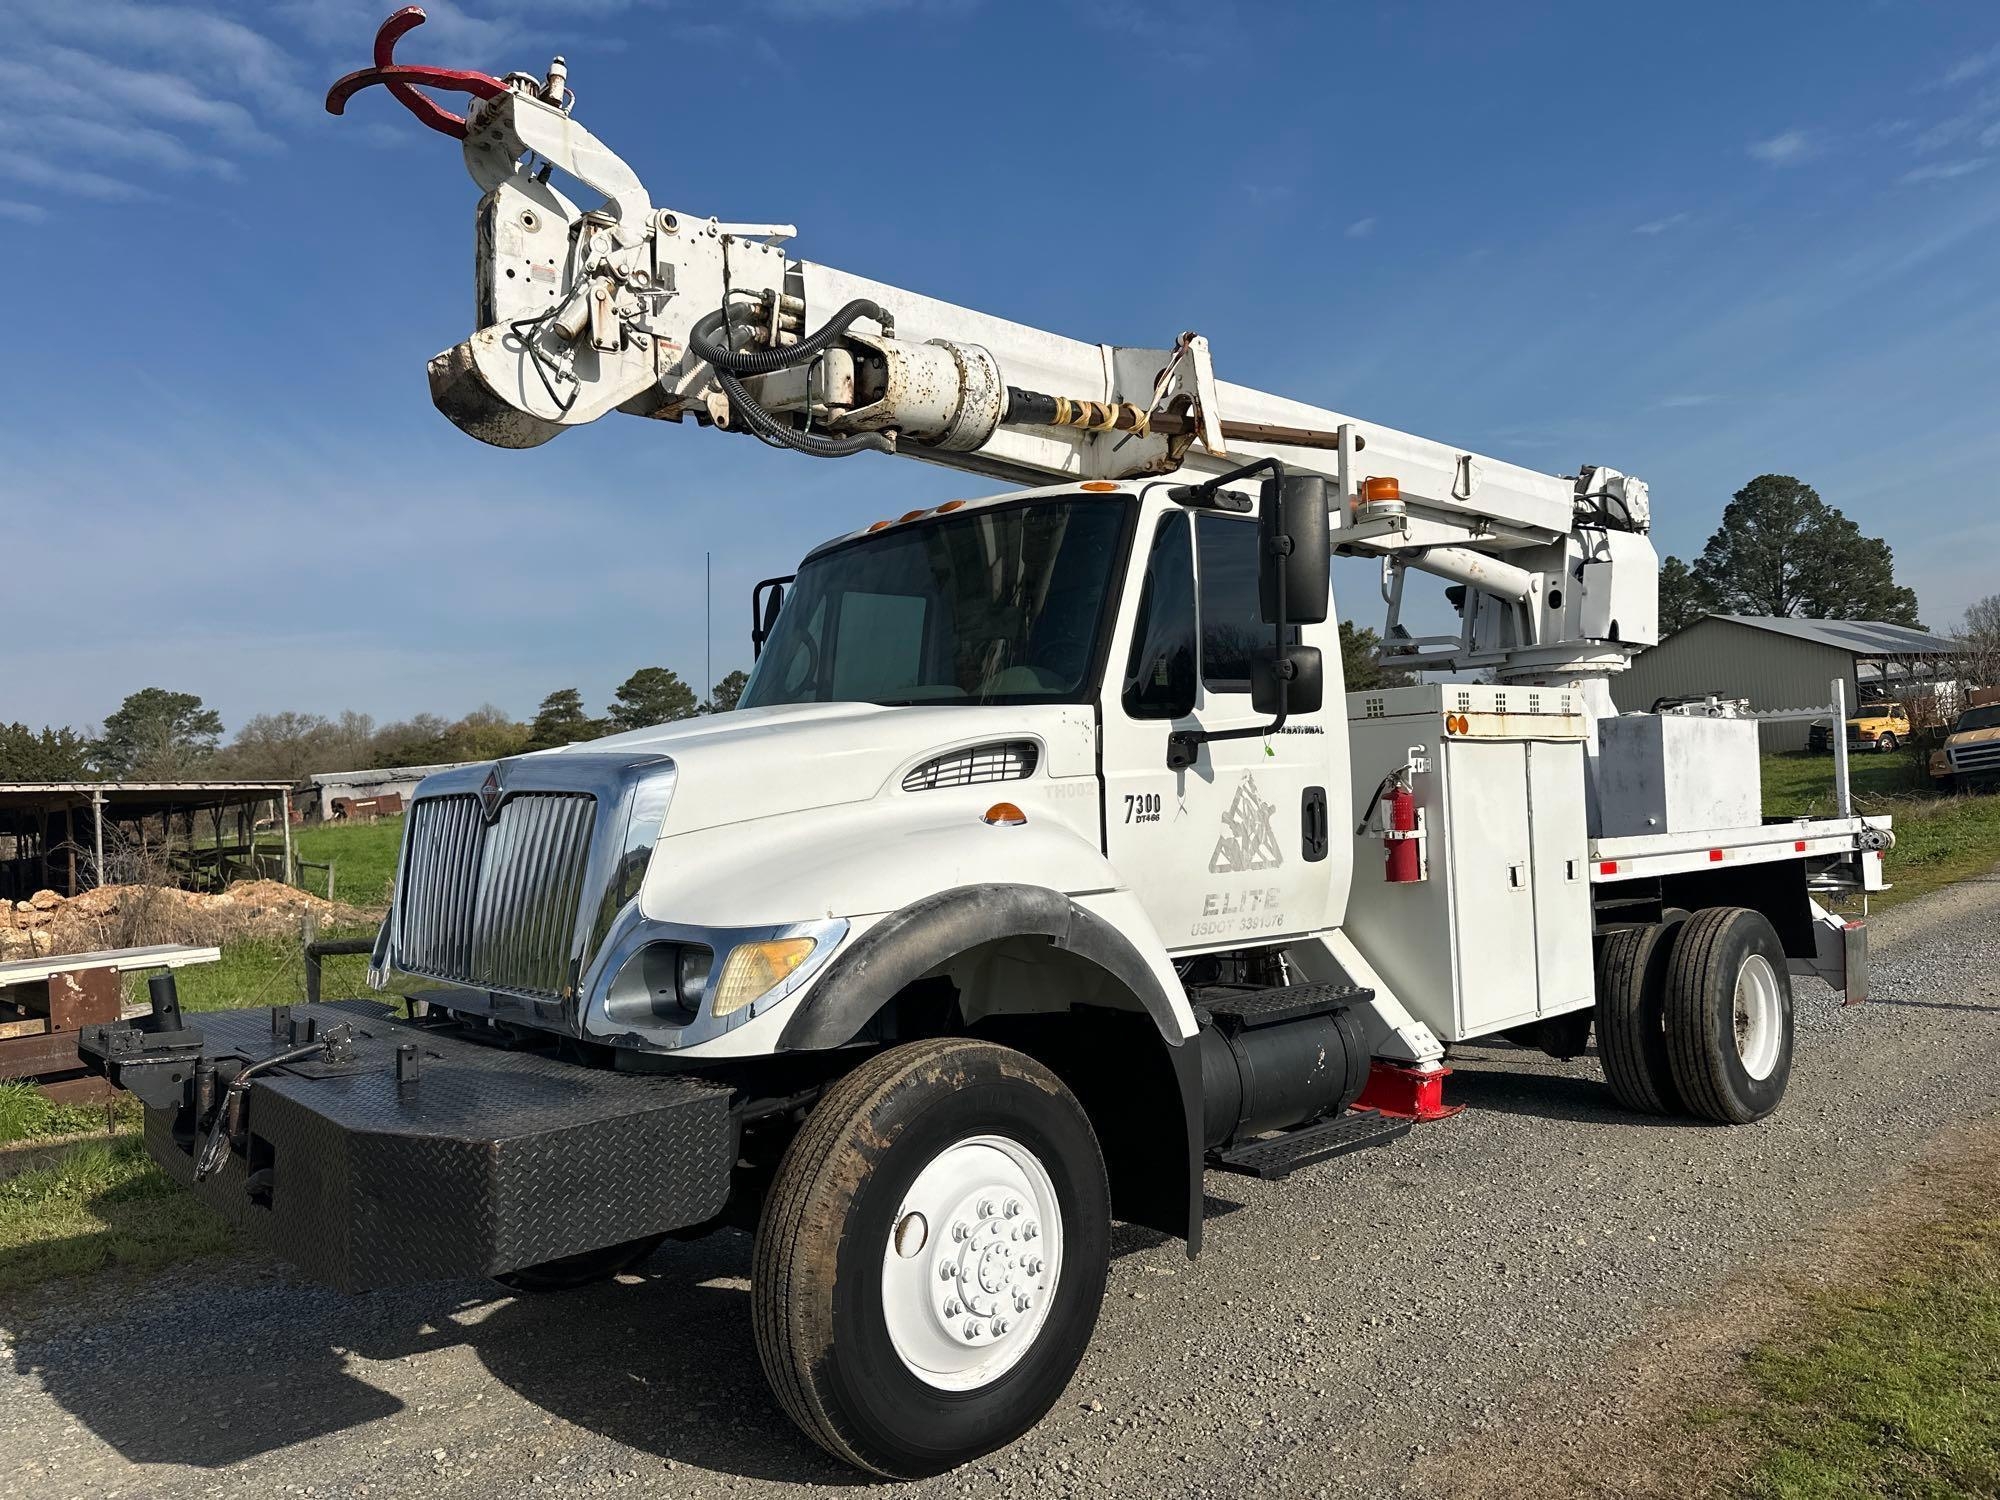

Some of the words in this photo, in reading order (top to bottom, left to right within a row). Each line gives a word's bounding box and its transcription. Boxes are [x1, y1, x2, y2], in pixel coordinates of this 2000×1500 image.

[1276, 725, 1325, 735] RNATIONAL
[1124, 793, 1161, 824] 7300
[1136, 813, 1160, 823] DT466
[1202, 887, 1280, 917] ELITE
